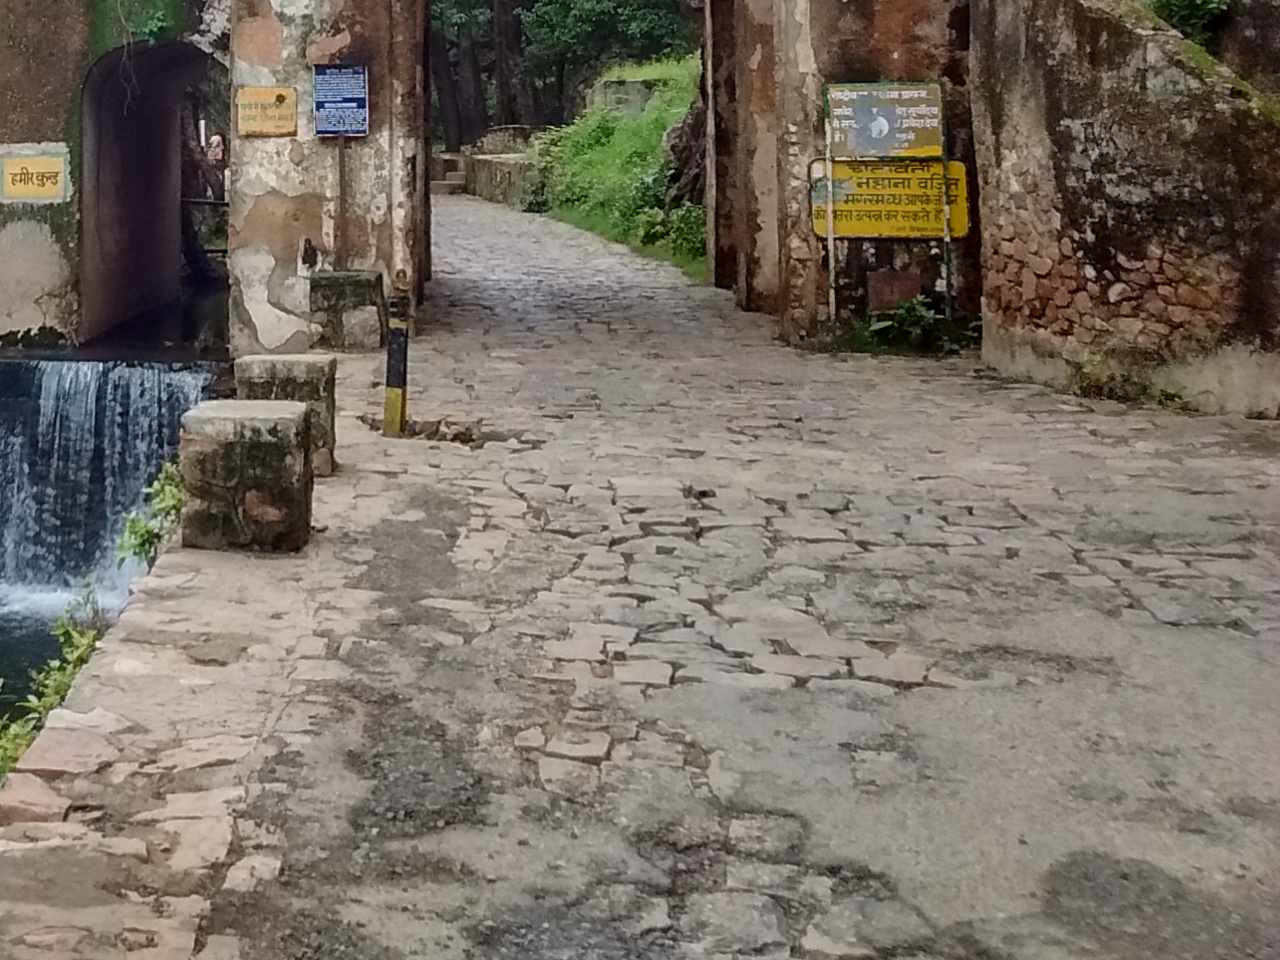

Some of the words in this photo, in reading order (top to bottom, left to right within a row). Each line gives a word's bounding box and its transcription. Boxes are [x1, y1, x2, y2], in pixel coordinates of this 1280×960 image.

[9, 166, 35, 186] हमीर
[856, 176, 912, 190] नहाना
[903, 191, 932, 205] आपके
[933, 191, 959, 205] जीन
[884, 210, 899, 222] कर
[901, 208, 932, 222] सकते
